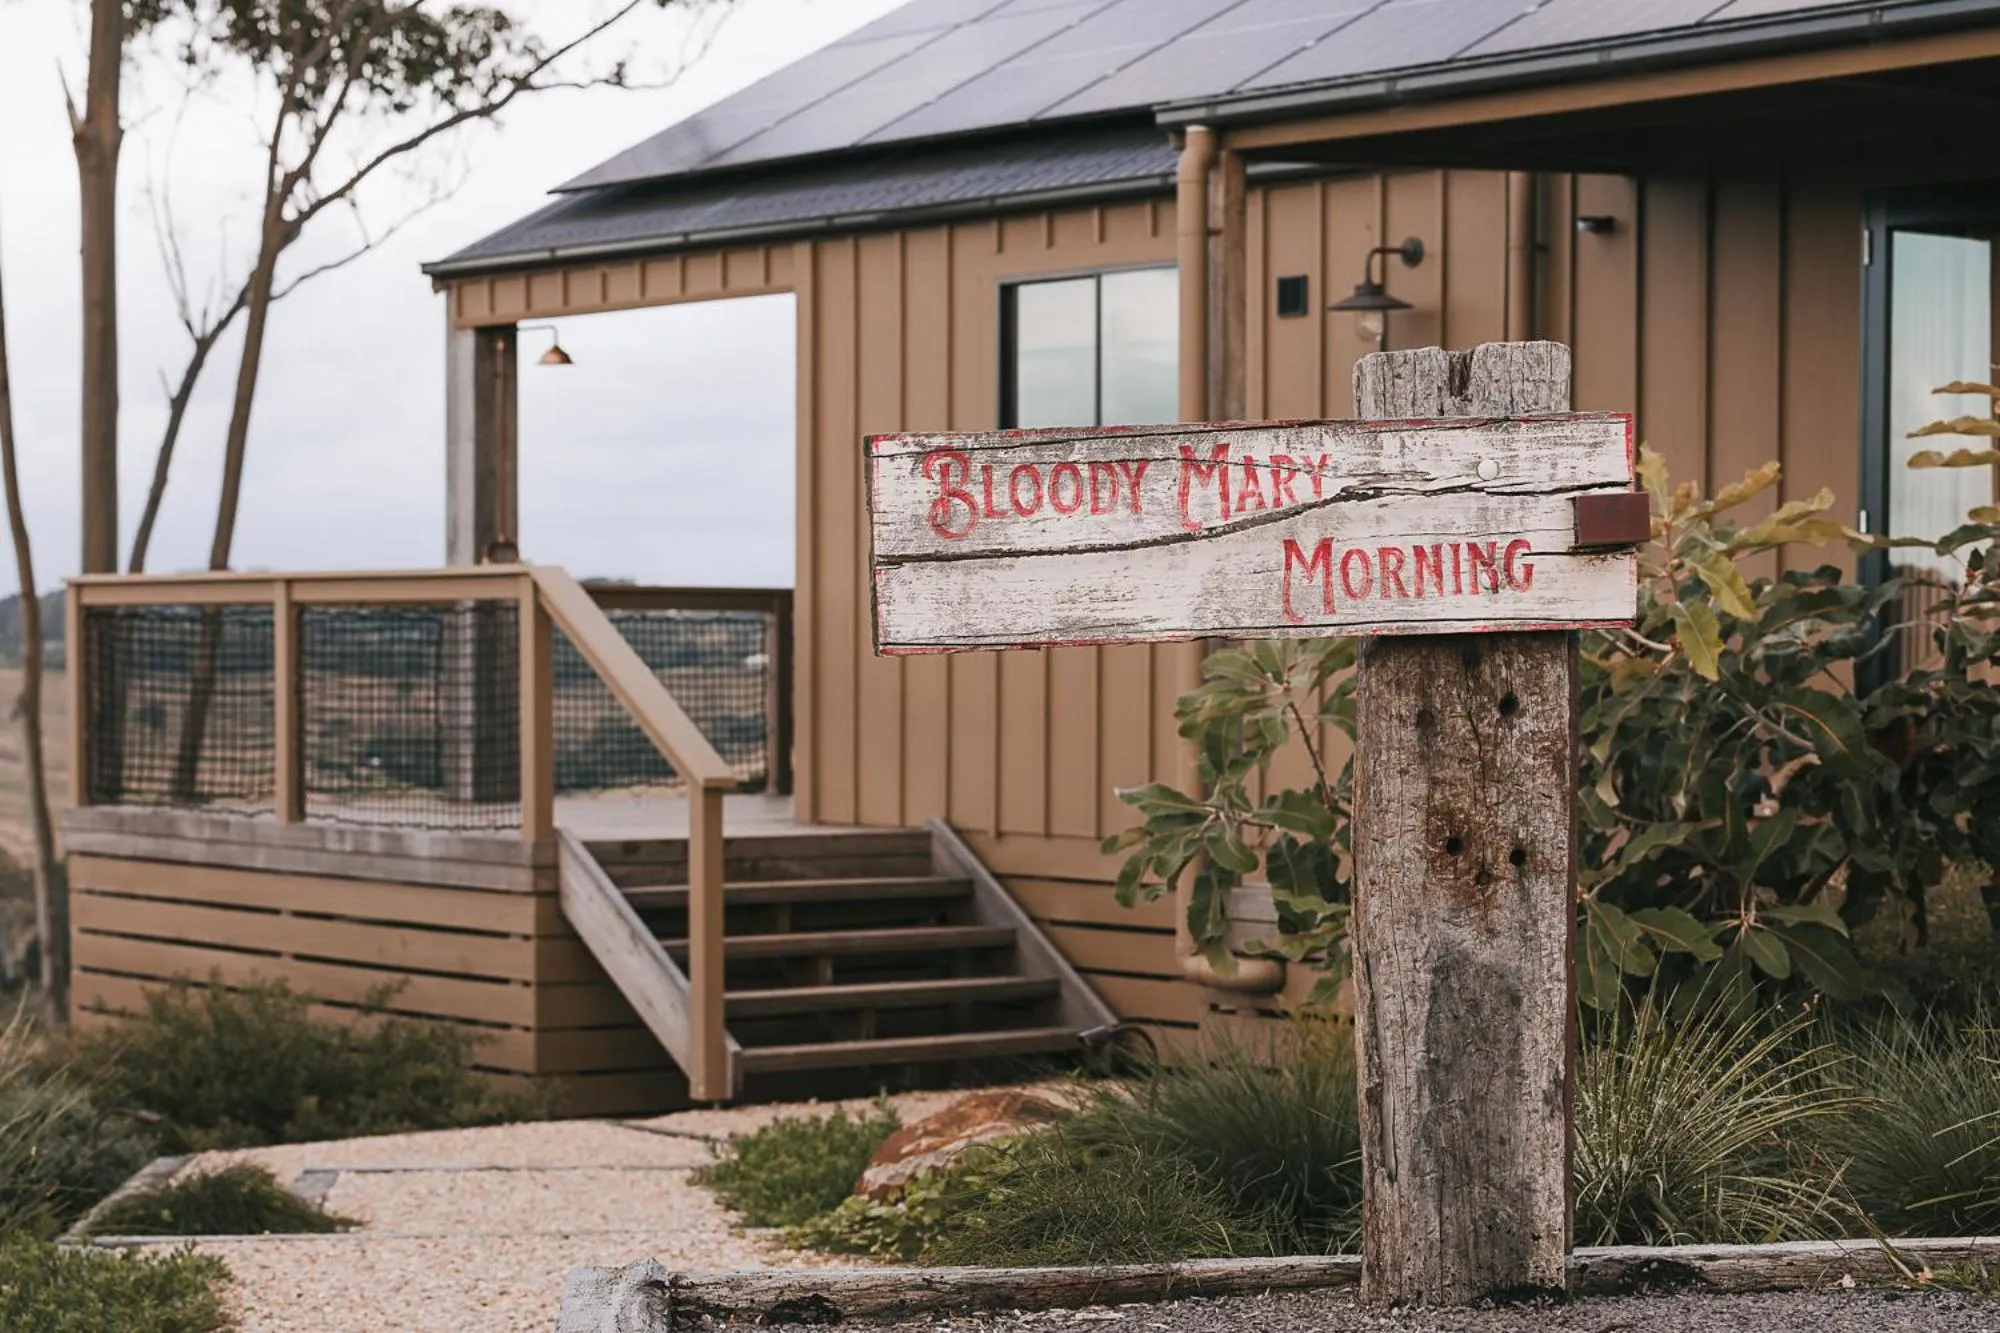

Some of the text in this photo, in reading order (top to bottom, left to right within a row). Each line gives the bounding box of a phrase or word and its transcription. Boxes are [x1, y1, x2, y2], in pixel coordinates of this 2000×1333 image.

[921, 443, 1332, 541] BLOODY MARY
[1282, 537, 1535, 625] MORNING
